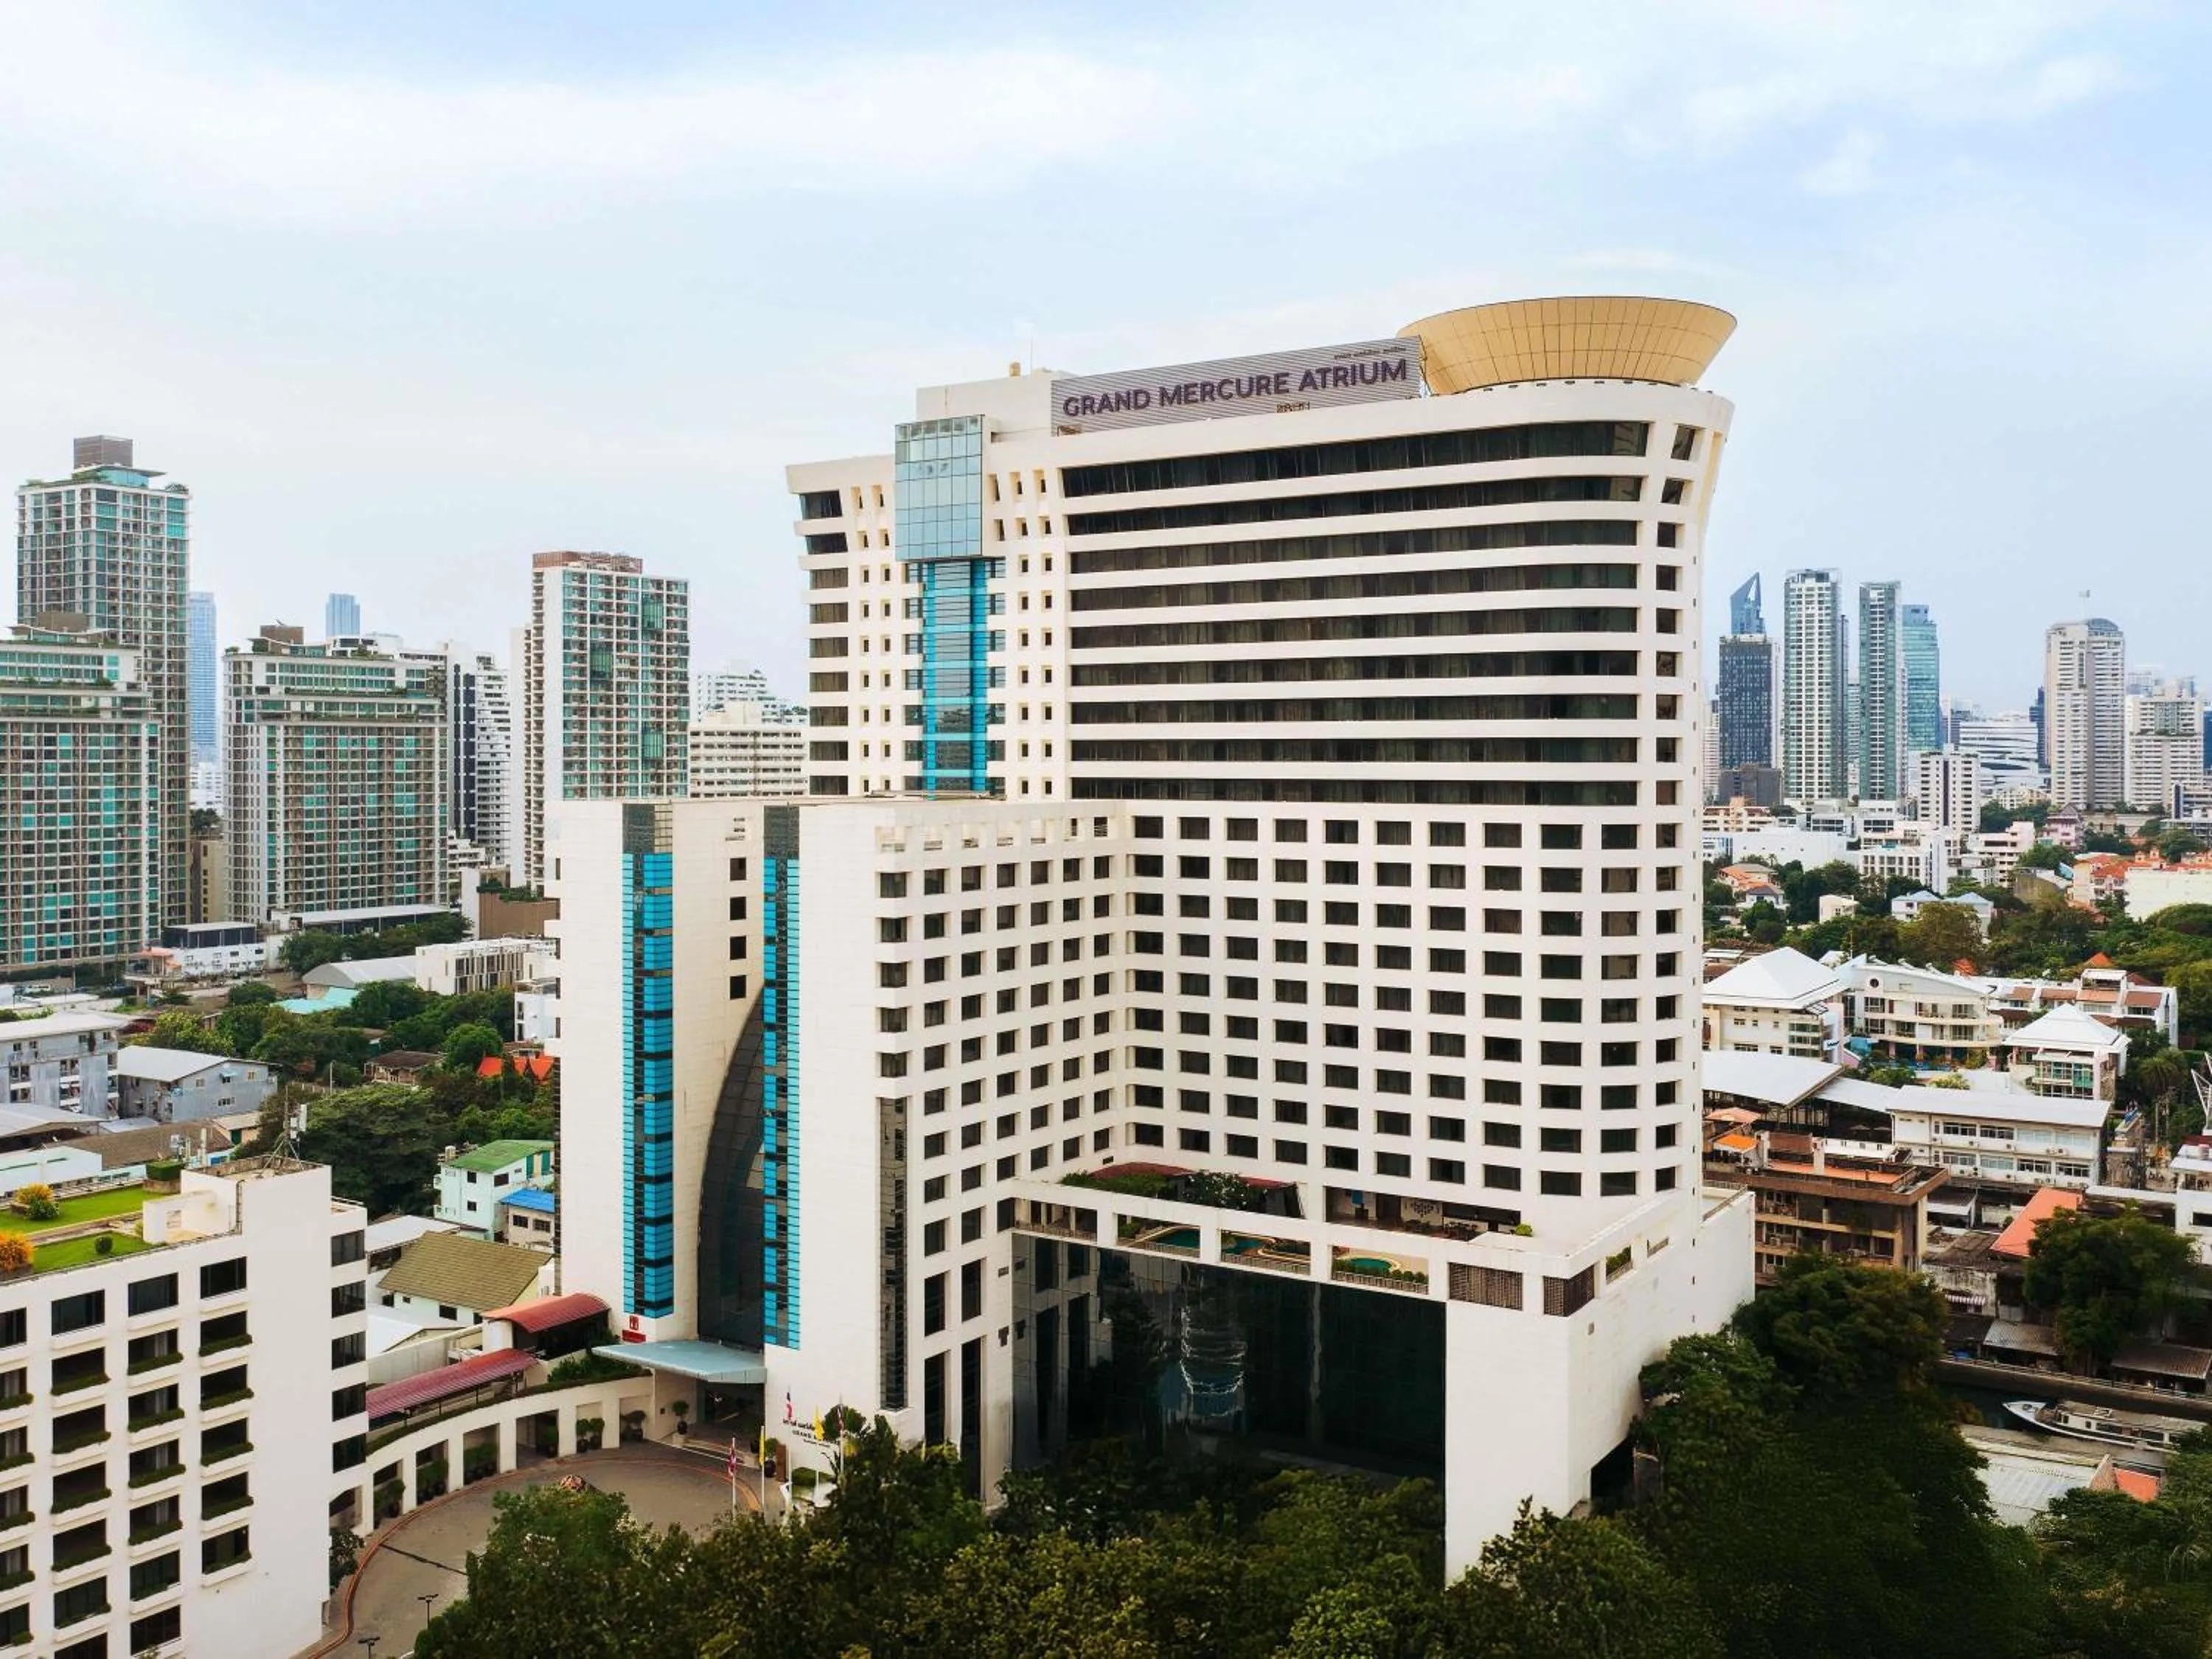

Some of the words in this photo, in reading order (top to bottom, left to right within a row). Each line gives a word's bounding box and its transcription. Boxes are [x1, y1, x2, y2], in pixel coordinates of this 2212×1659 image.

[1062, 389, 1151, 417] GRAND
[1158, 372, 1290, 406] MERCURE
[1298, 358, 1407, 392] ATRIUM
